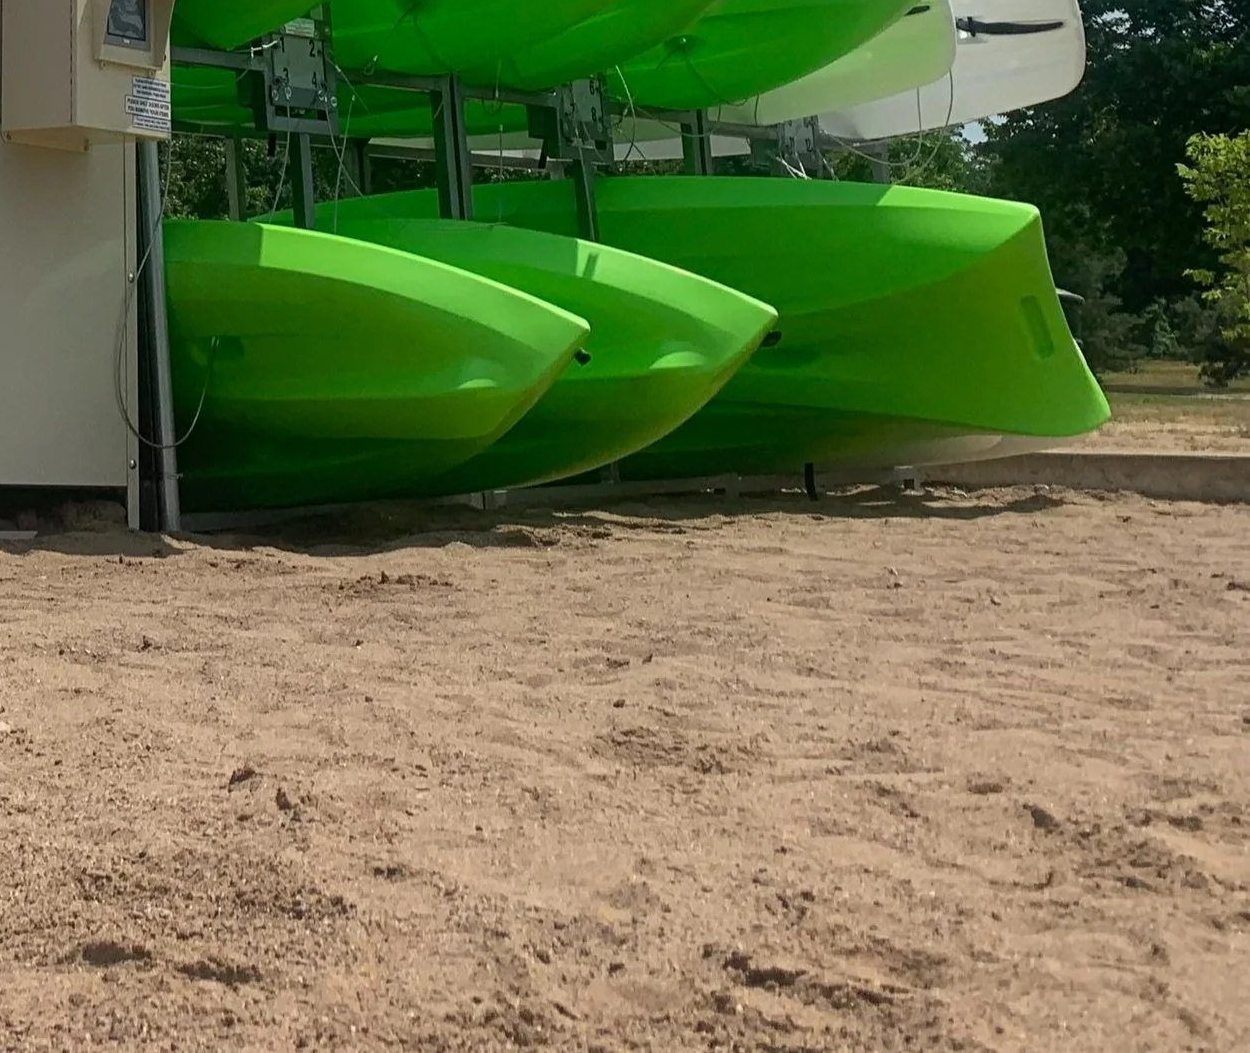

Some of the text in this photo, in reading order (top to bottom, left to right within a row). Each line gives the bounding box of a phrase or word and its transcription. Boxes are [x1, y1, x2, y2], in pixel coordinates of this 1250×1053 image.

[280, 36, 285, 53] 1
[309, 39, 316, 58] 2
[311, 71, 317, 88] 4
